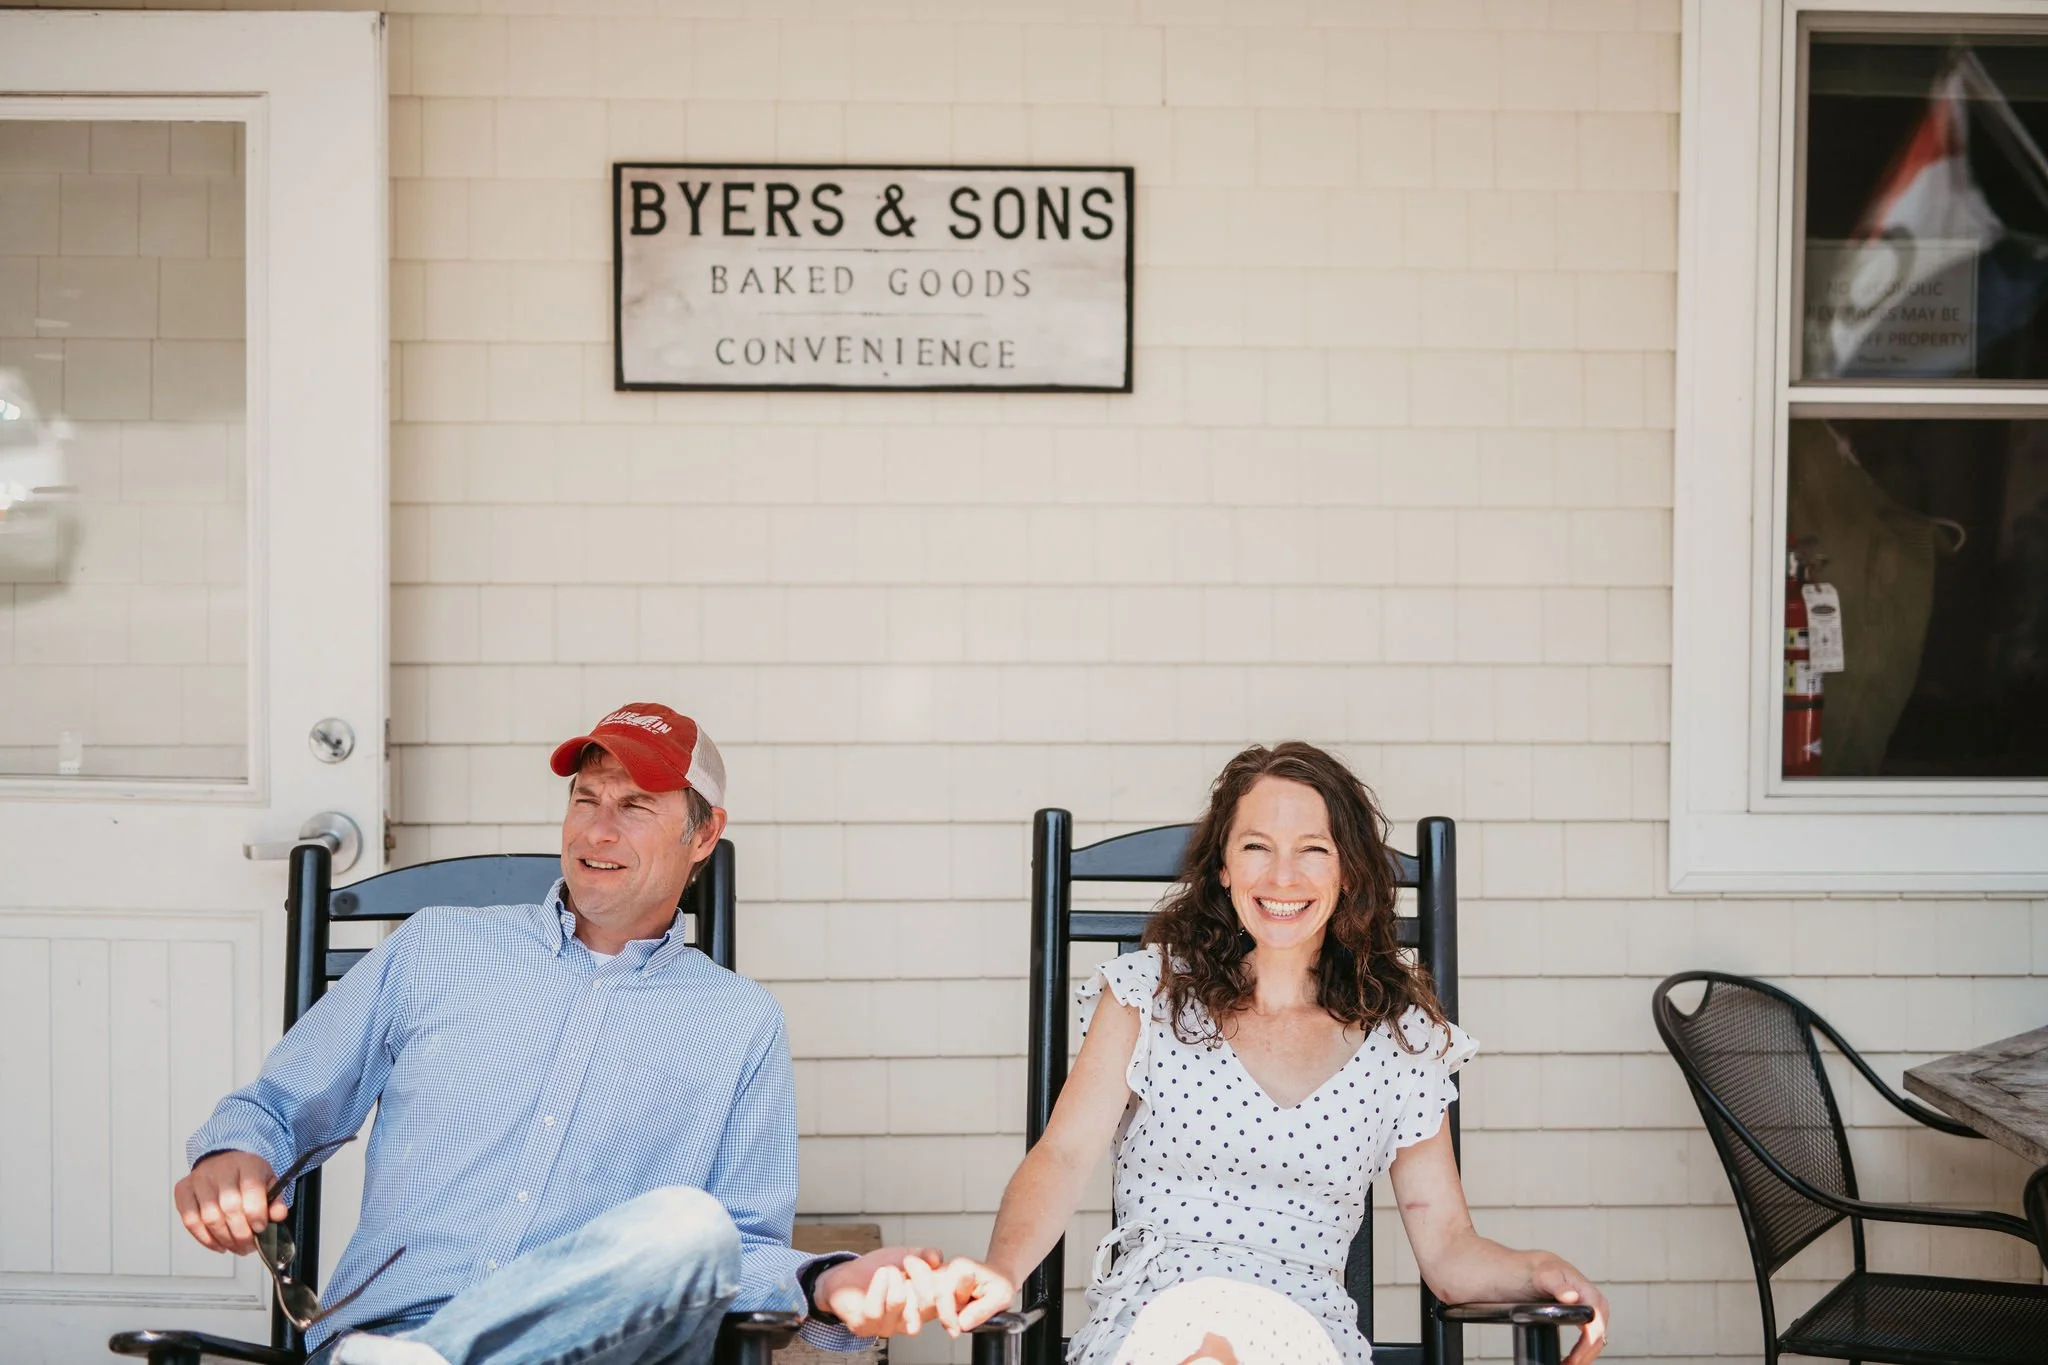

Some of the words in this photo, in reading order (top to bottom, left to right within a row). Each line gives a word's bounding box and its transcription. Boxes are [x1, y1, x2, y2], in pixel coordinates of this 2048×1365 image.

[630, 181, 844, 238] BYERS
[875, 184, 916, 238] &
[949, 187, 1114, 241] SONS
[711, 265, 854, 296] BAKED
[888, 268, 1032, 299] GOODS
[1902, 307, 1936, 321] MAY
[1942, 307, 1961, 321] BE
[715, 336, 1016, 370] CONVENIENCE
[1888, 331, 1968, 347] PROPERTY
